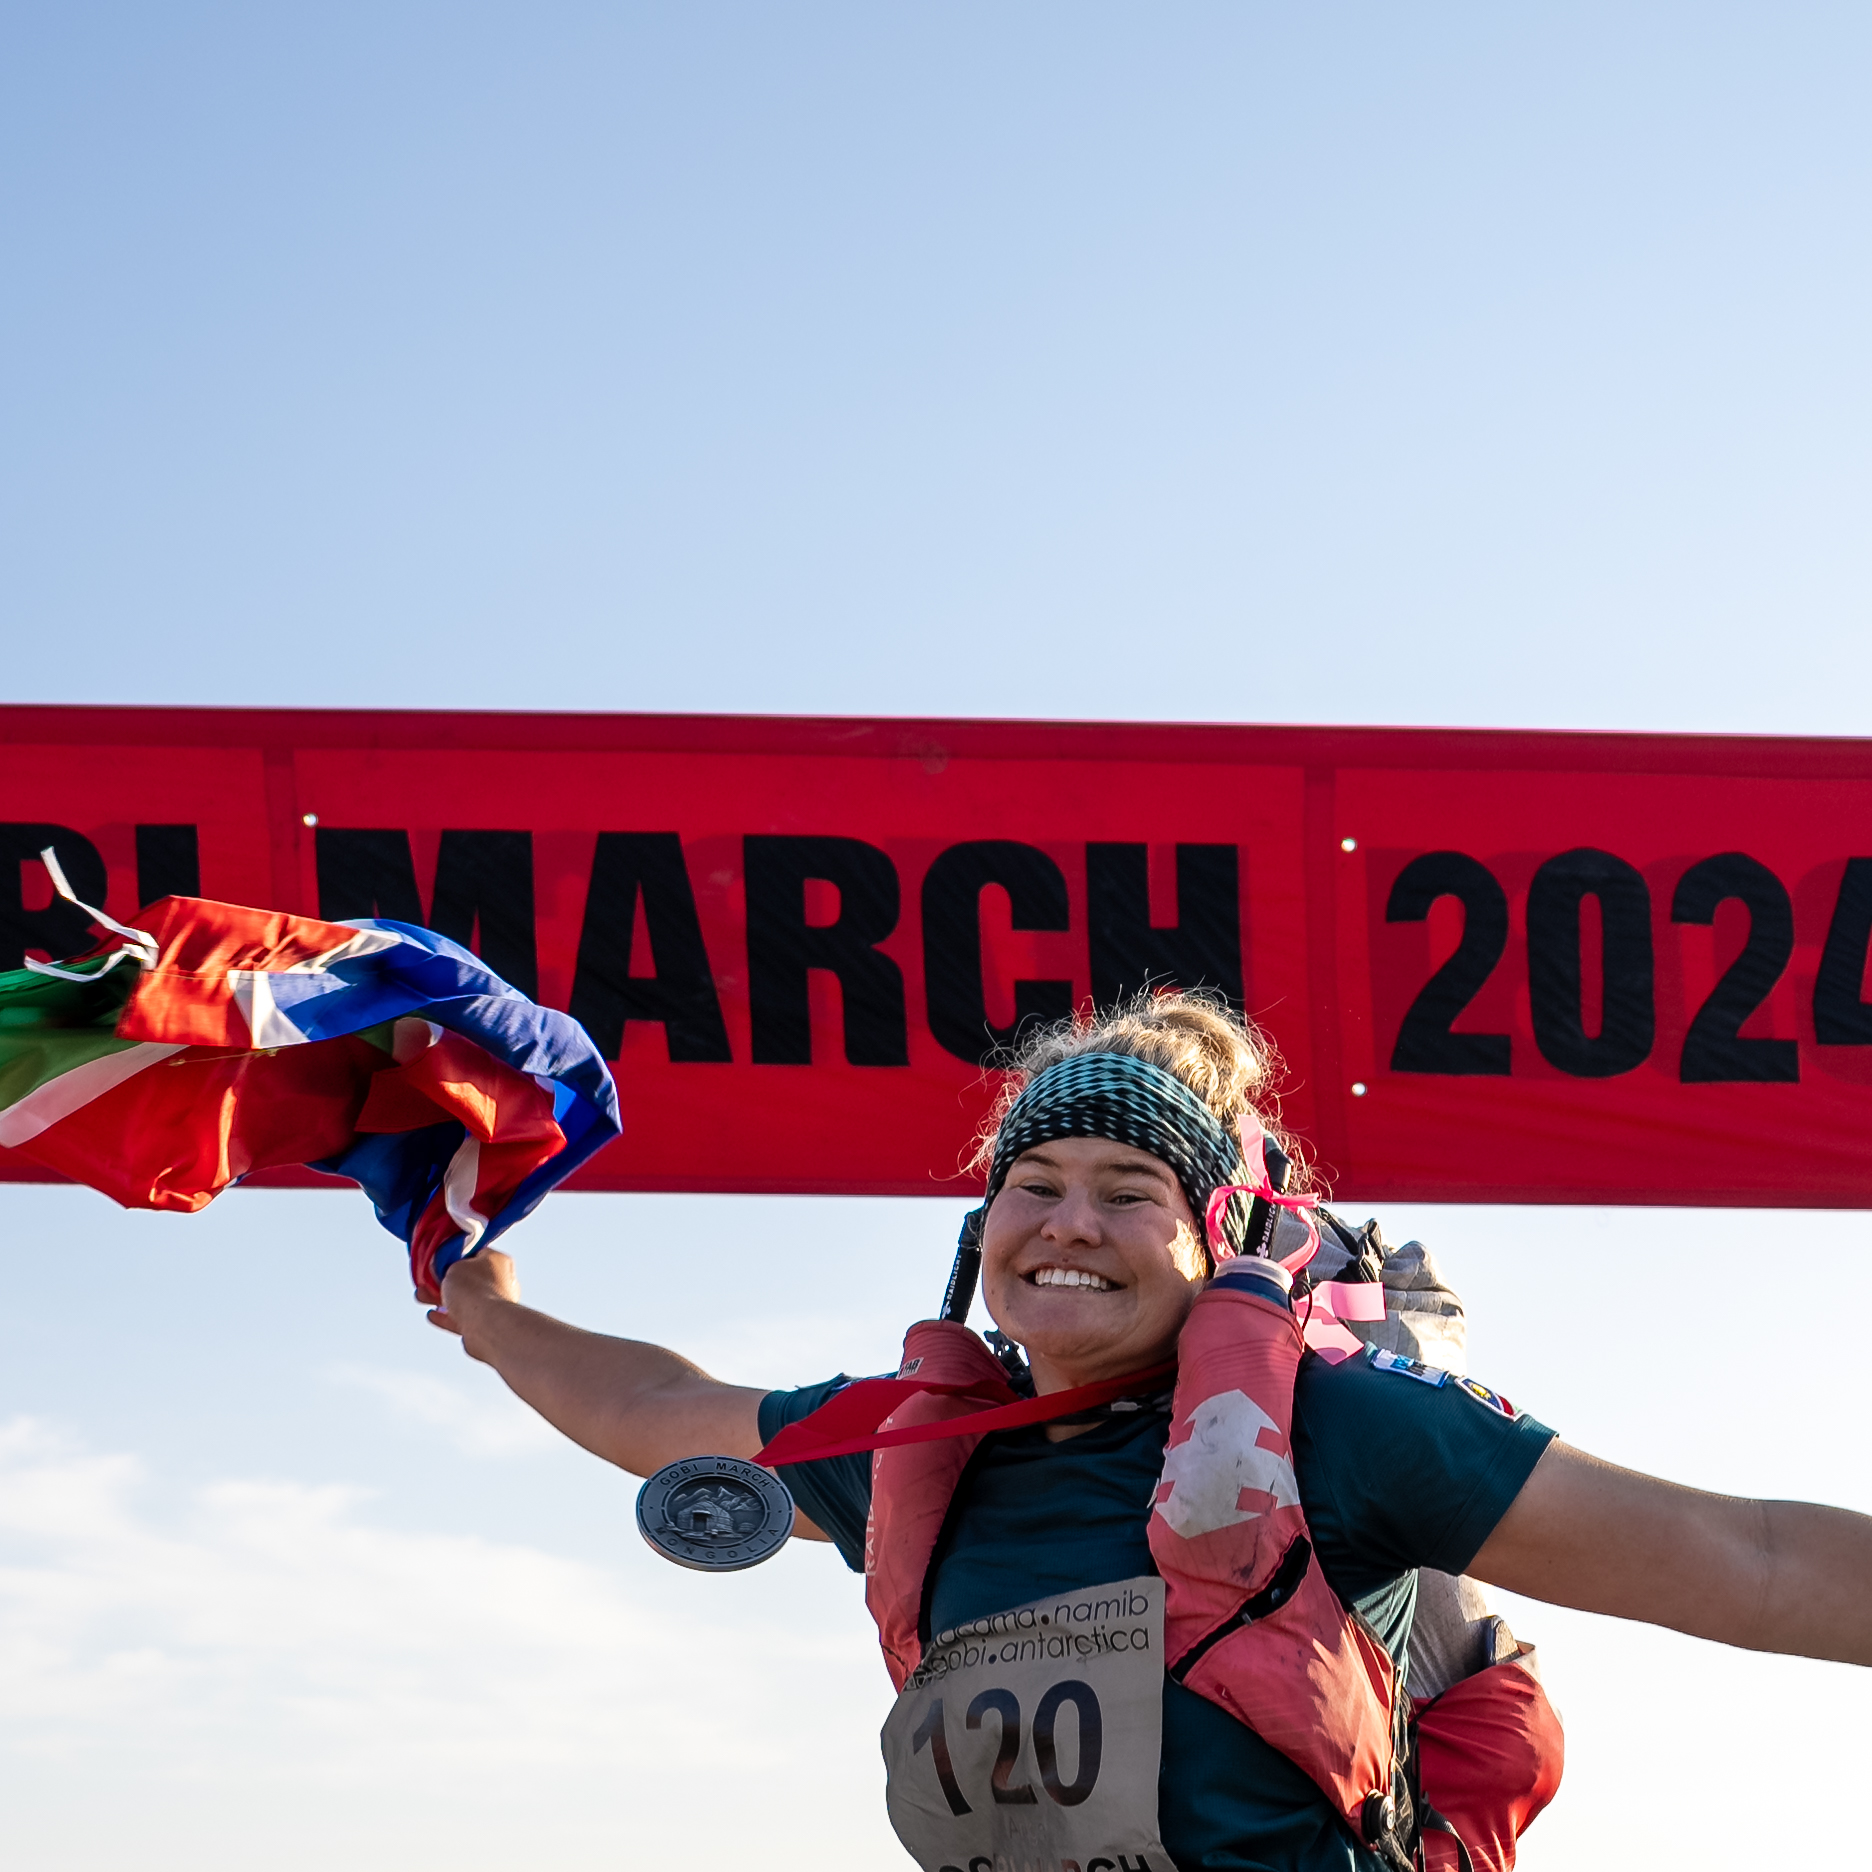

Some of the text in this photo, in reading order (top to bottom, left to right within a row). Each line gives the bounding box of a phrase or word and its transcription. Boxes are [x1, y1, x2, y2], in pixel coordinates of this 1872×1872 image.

[315, 828, 1246, 1068] MARCH
[659, 1462, 770, 1488] GOBI MARCH
[654, 1526, 779, 1560] MONGOLIA
[912, 1679, 1104, 1817] 120
